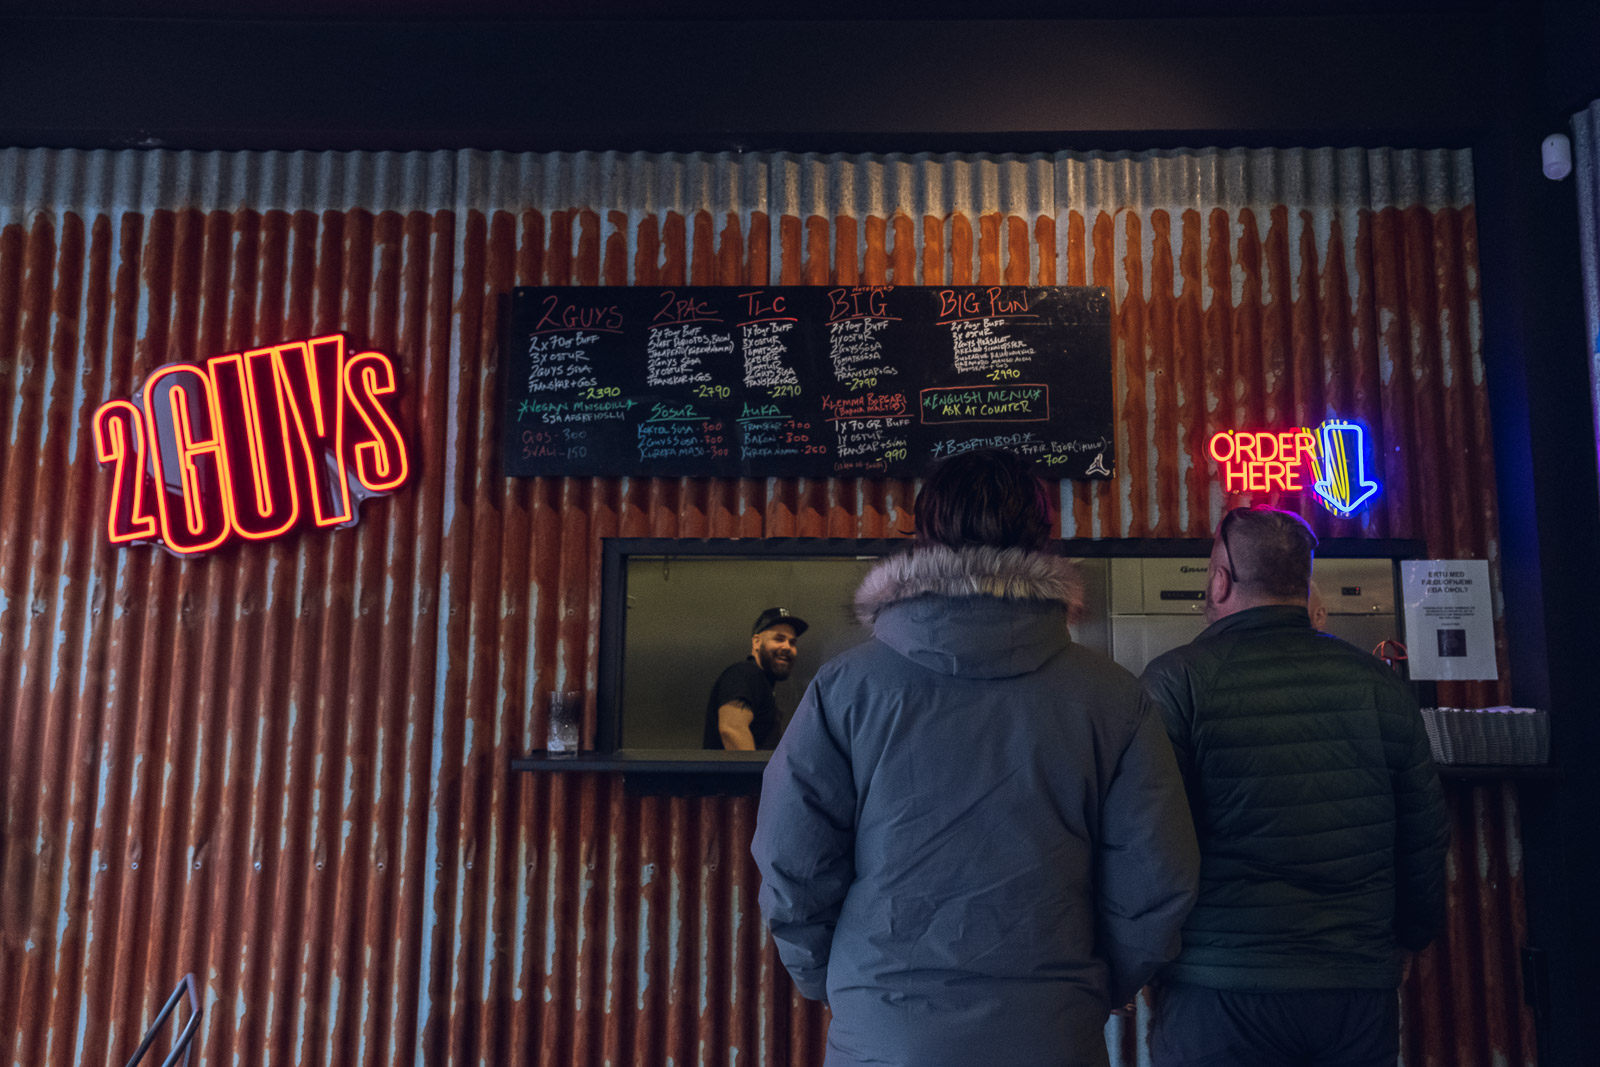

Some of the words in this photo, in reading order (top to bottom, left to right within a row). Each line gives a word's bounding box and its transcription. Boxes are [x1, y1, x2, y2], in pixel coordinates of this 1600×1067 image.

[653, 290, 718, 322] 2PAC
[738, 291, 786, 316] TLC
[940, 290, 980, 317] BIG
[986, 287, 1028, 317] PUN
[983, 318, 1005, 329] BUFF
[576, 331, 600, 346] BUFF
[741, 402, 780, 417] AUKA
[942, 403, 961, 416] ASK
[964, 405, 977, 416] AT
[980, 401, 1032, 416] COUNTER
[886, 418, 910, 427] BUFF
[1210, 432, 1316, 463] ORDER
[1226, 461, 1303, 492] HERE
